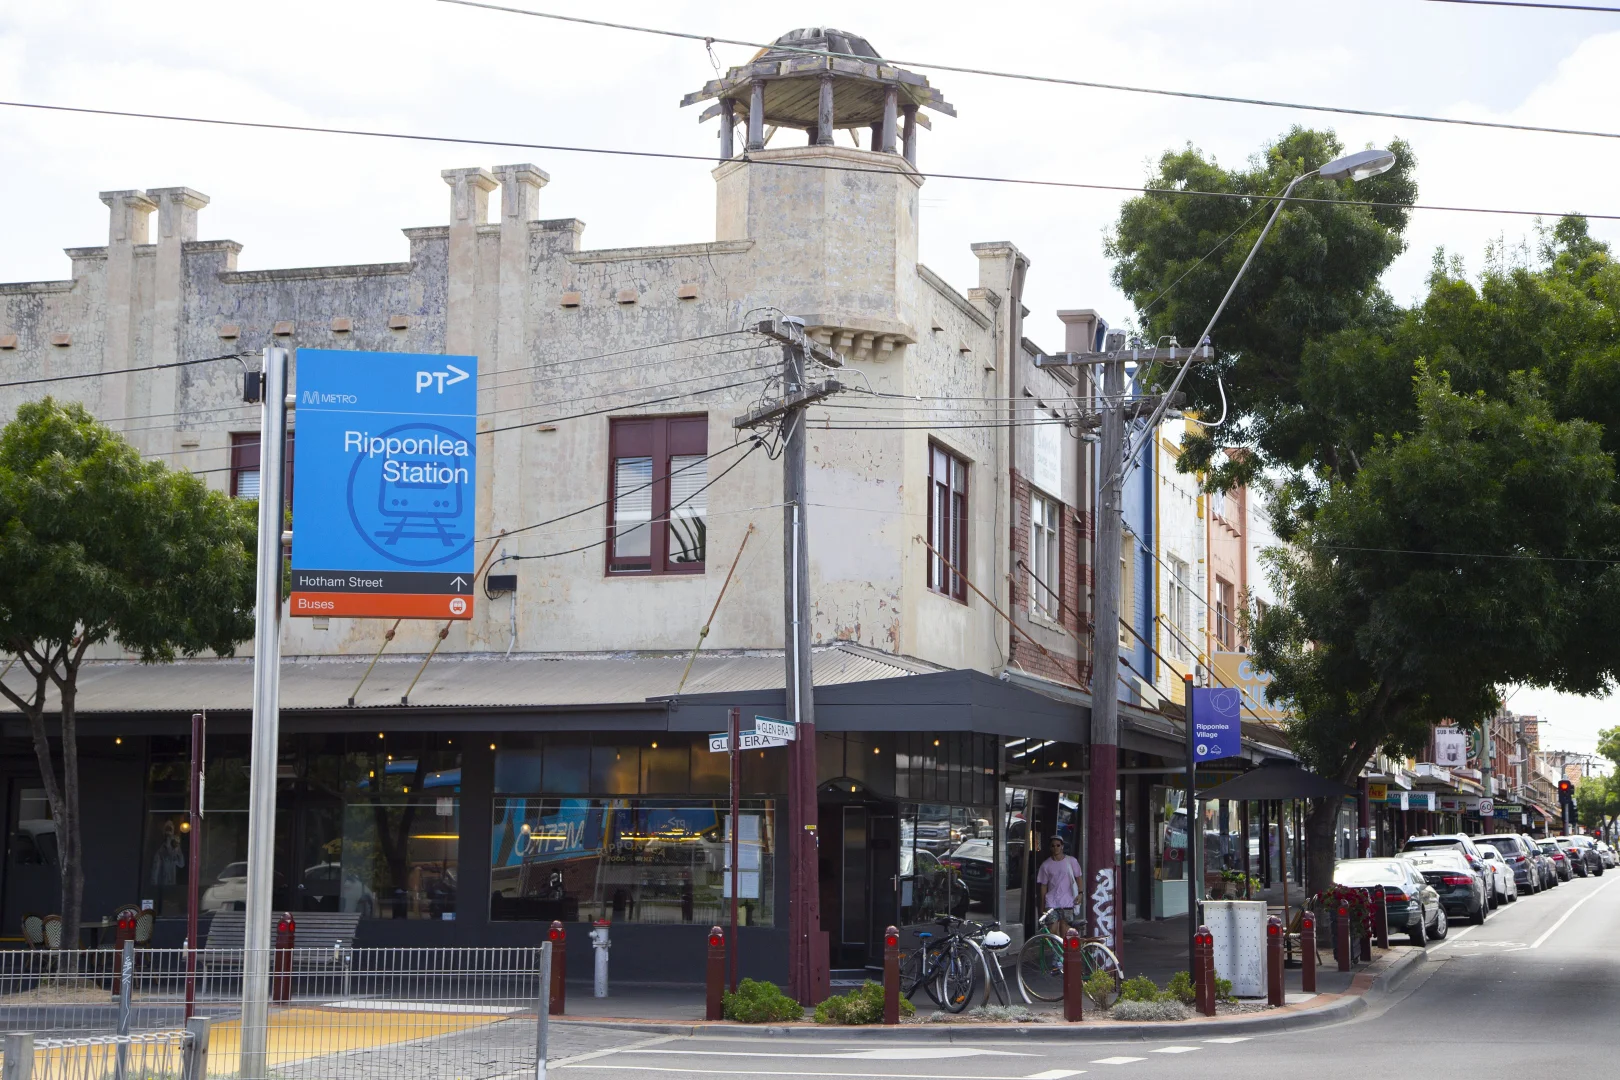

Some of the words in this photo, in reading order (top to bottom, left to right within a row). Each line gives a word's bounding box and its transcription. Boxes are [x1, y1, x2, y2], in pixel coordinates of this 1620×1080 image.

[321, 393, 358, 404] METRO
[344, 430, 469, 459] Ripponlea
[382, 459, 469, 484] Station
[299, 575, 345, 587] Hotham
[348, 576, 383, 588] Street
[298, 598, 335, 610] Buses
[761, 722, 777, 735] GLEN
[777, 725, 790, 737] EIRA
[1196, 723, 1230, 731] Ripponlea
[1196, 731, 1218, 739] Village
[711, 737, 742, 750] GL
[744, 735, 771, 747] EIRA
[1481, 803, 1492, 811] 60
